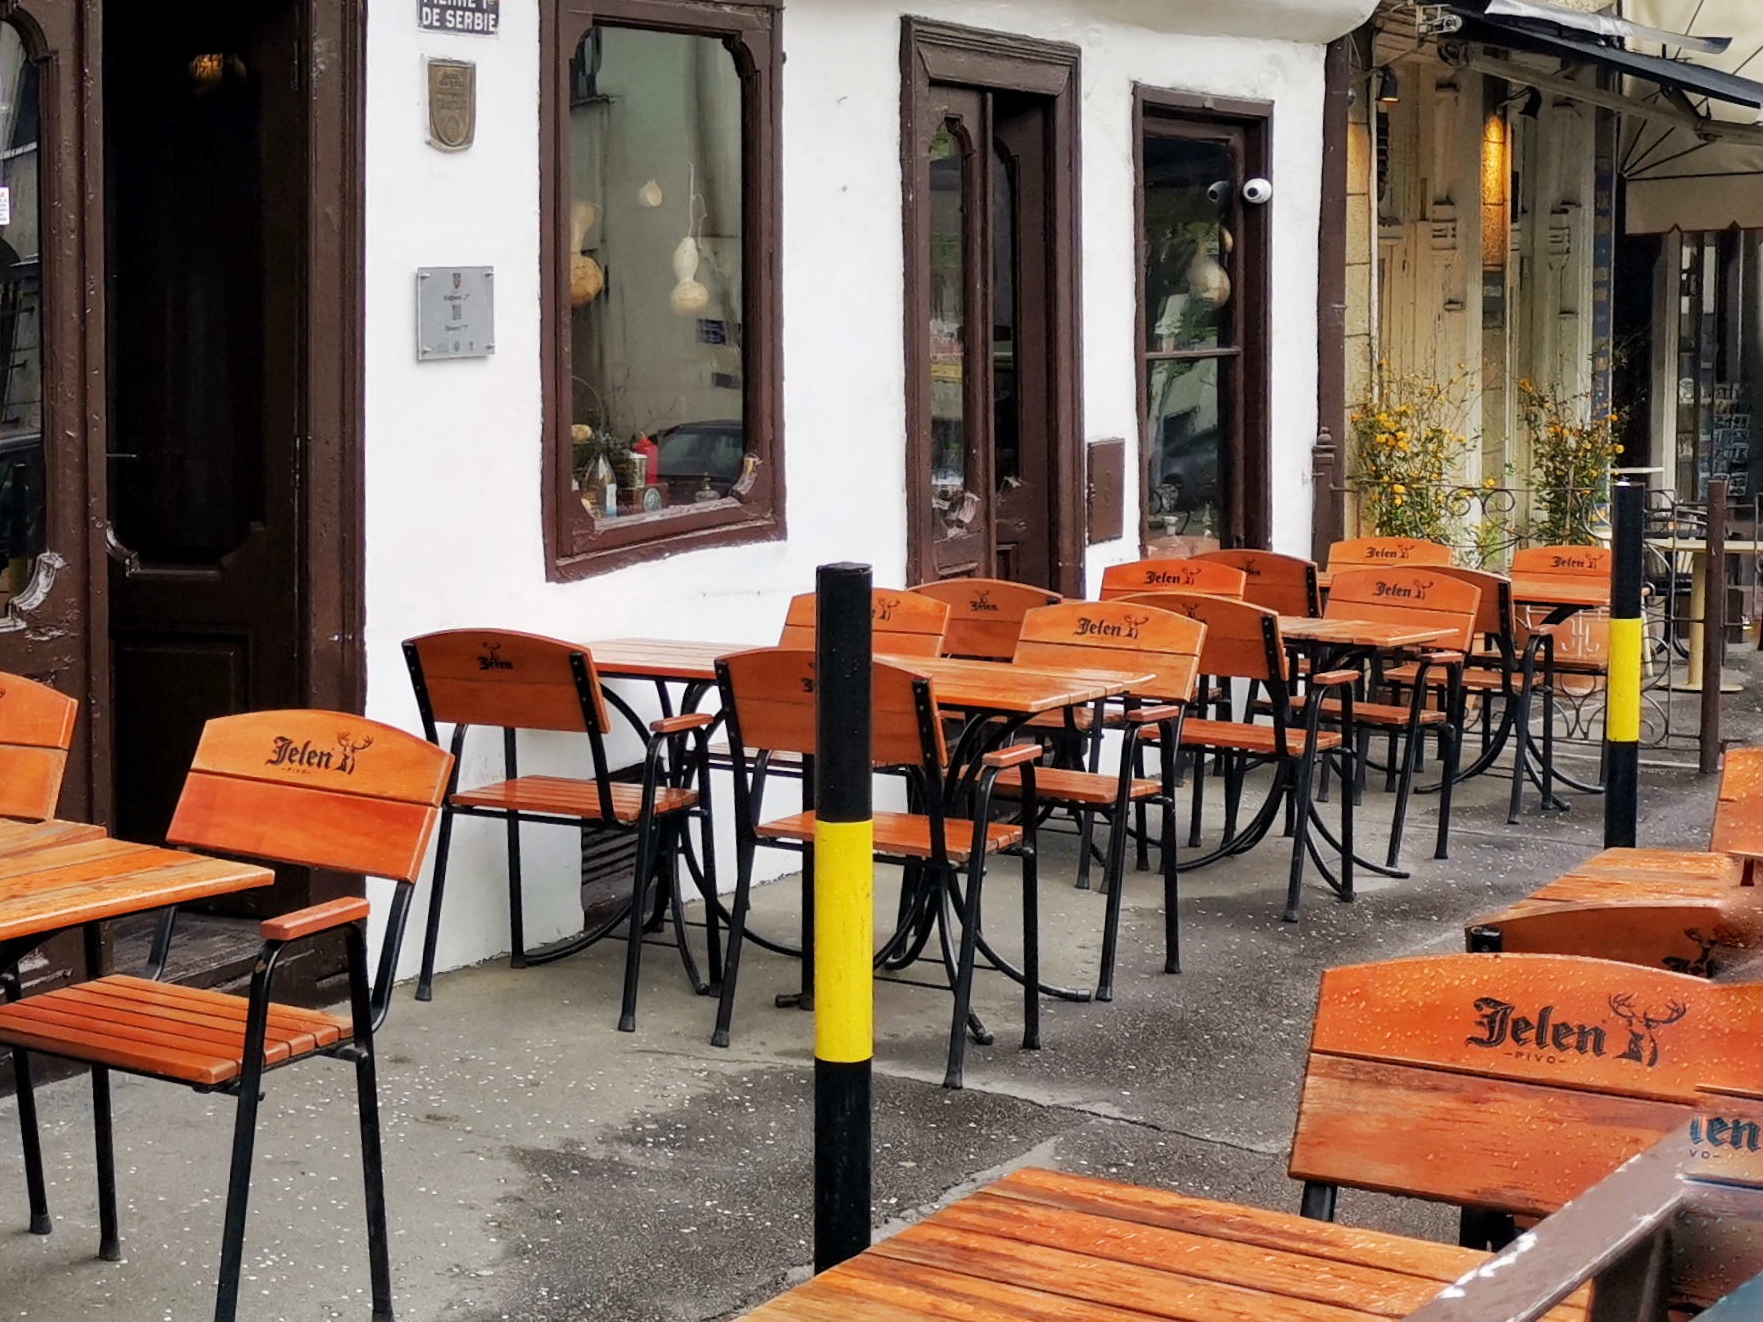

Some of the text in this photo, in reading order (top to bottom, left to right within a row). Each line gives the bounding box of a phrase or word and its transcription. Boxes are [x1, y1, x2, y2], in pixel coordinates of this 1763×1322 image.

[422, 7, 497, 31] DE SERBIE
[1365, 546, 1397, 558] Jelen
[1143, 570, 1180, 585] Jelen
[1373, 581, 1412, 598] Jelen
[1072, 617, 1121, 636] Jelen
[264, 736, 333, 770] Jelen
[1463, 996, 1607, 1058] Jelen
[1514, 1051, 1557, 1065] PIVO
